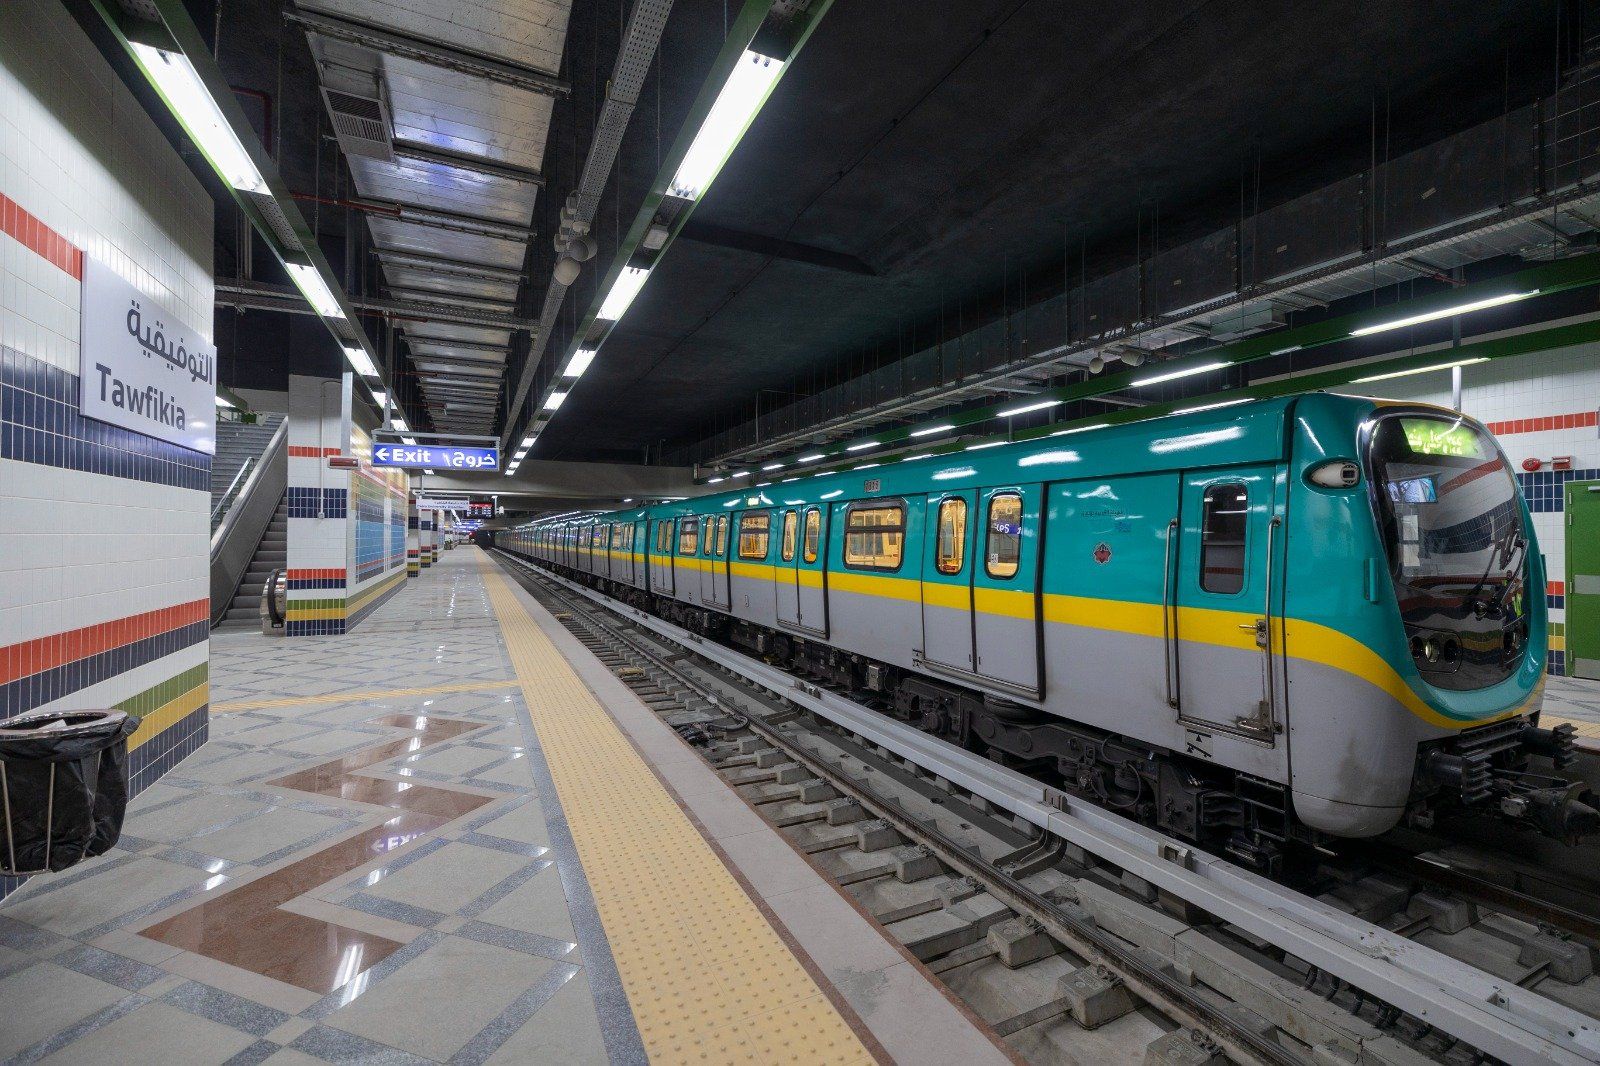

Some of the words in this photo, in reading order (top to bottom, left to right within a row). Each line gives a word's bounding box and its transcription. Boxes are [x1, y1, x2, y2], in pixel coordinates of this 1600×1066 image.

[126, 299, 213, 386] التوفيقية
[96, 362, 186, 431] Tawfikia
[392, 448, 431, 463] Exit
[452, 451, 496, 468] خروج
